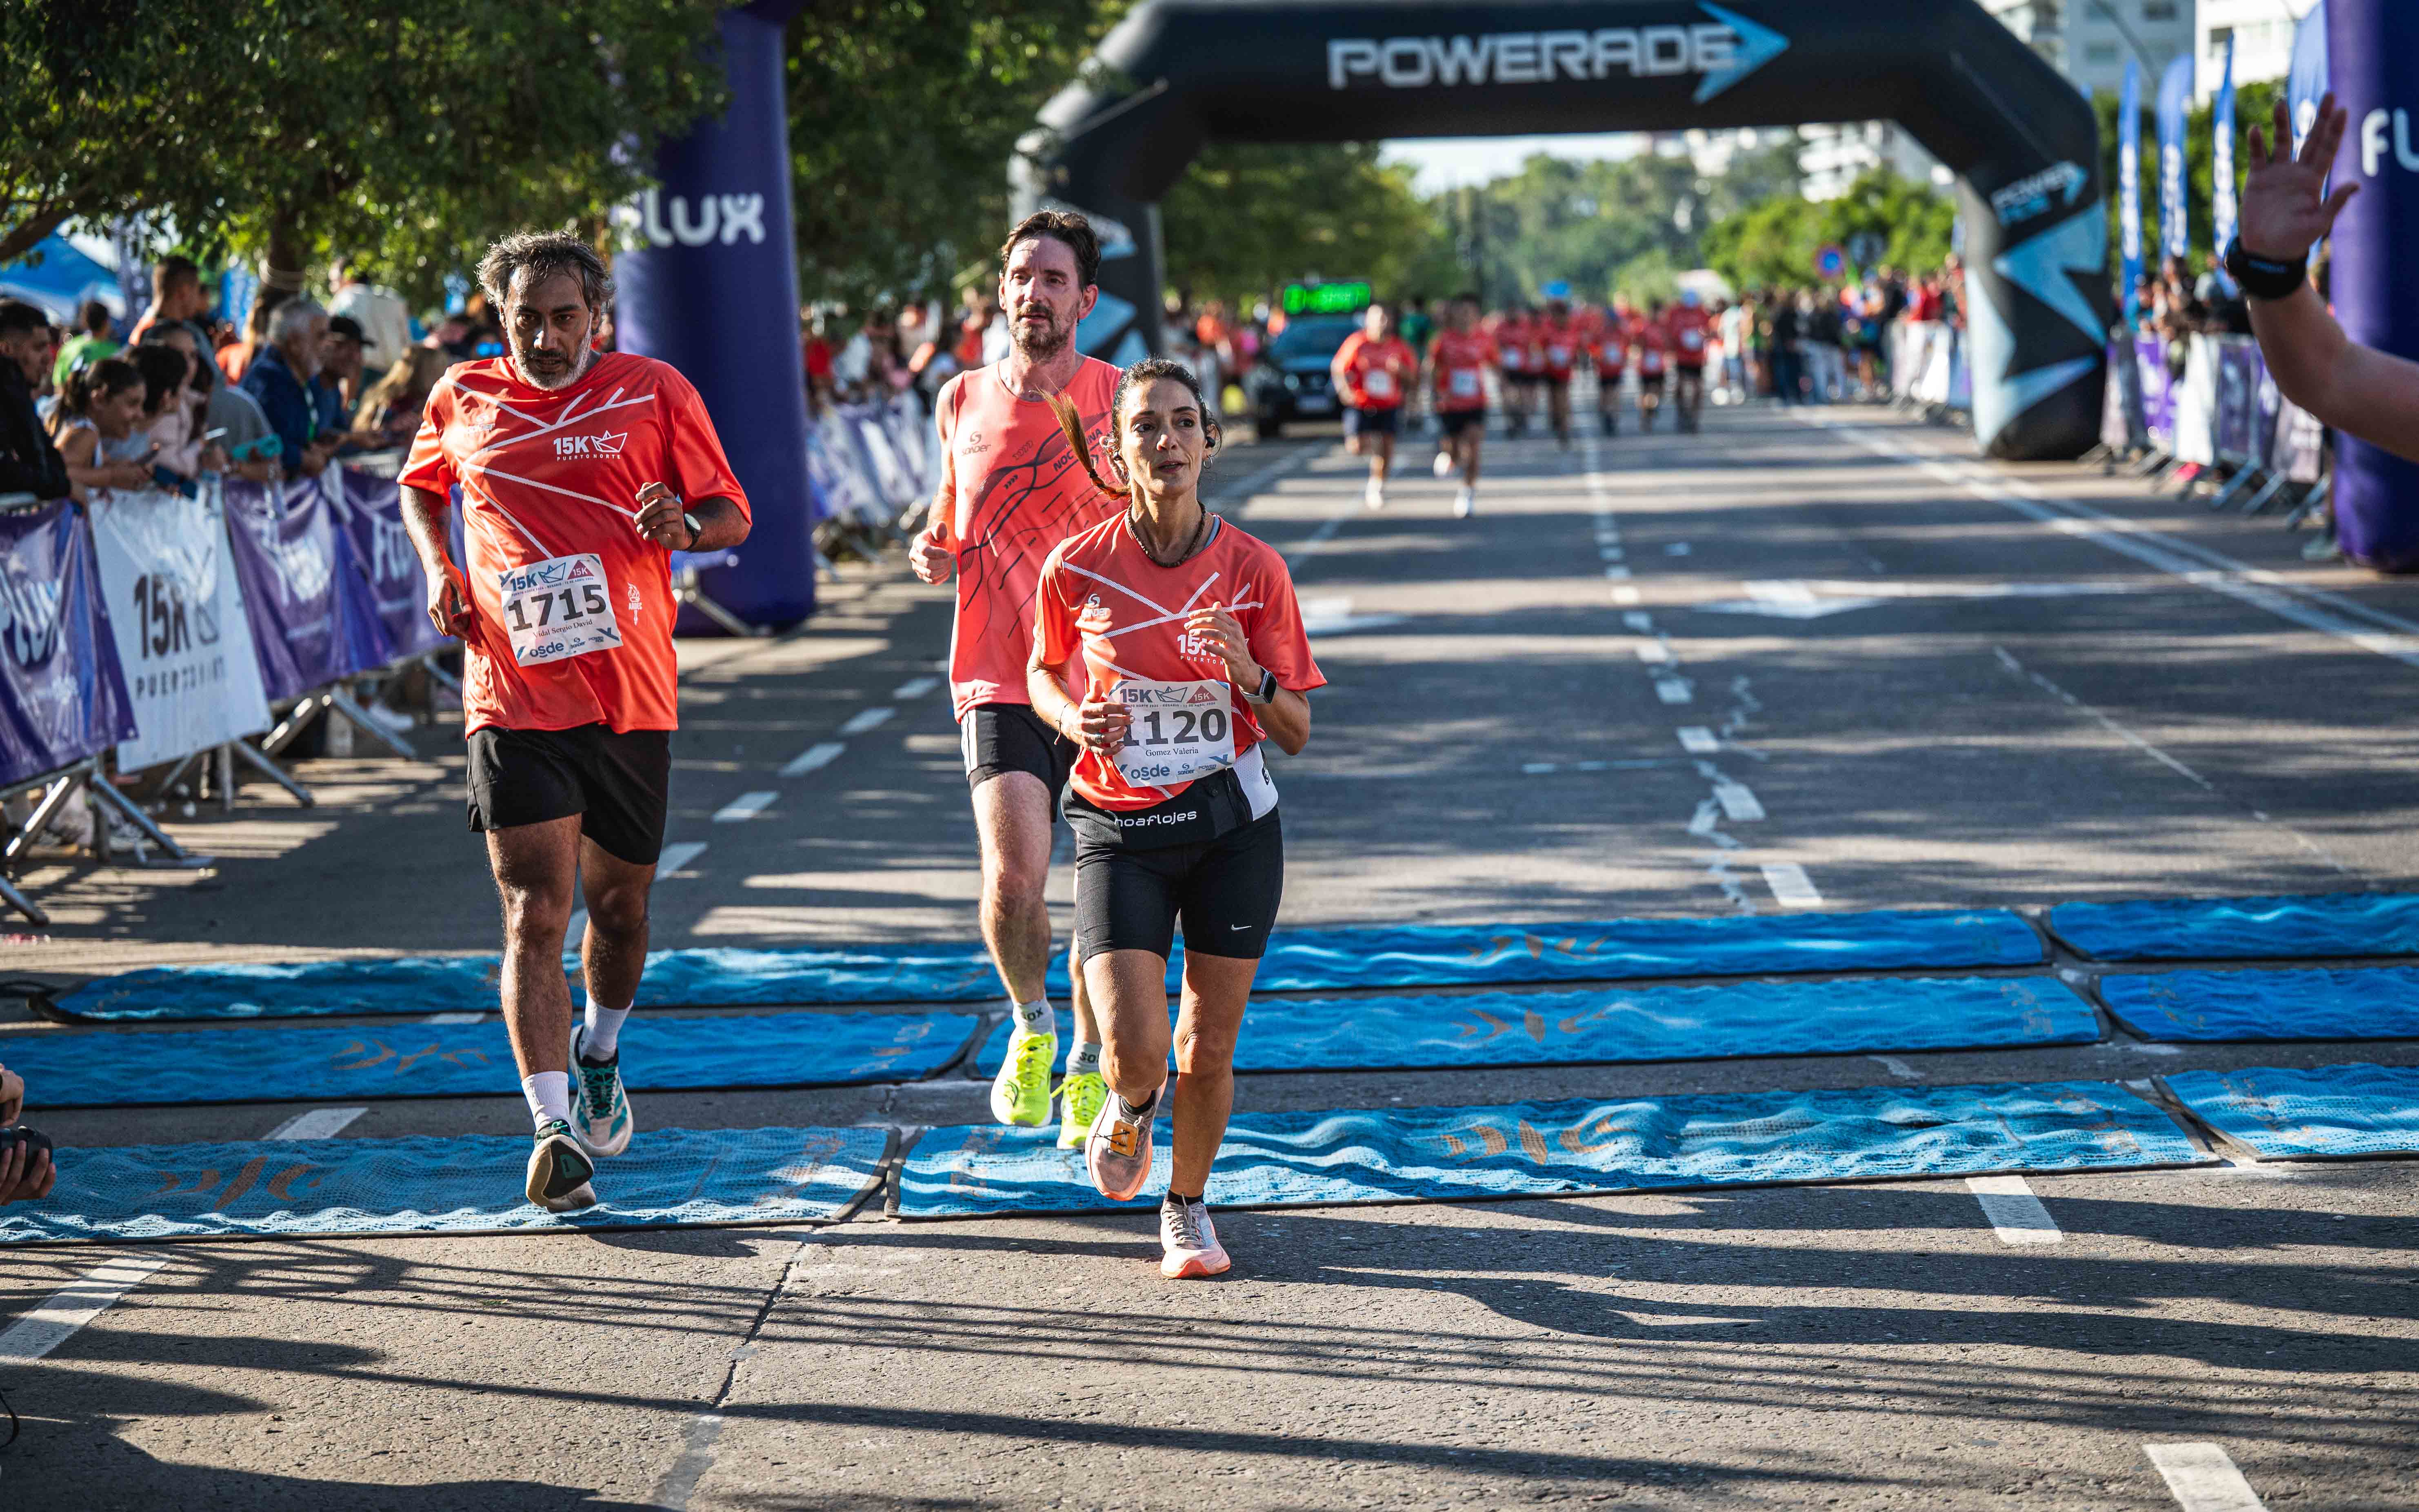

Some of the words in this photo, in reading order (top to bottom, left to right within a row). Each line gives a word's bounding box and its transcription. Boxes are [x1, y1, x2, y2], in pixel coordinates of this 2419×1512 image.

[1326, 23, 1738, 90] POWERADE
[553, 436, 589, 455] 15K
[510, 572, 538, 591] 15K
[572, 567, 587, 576] 15K
[508, 584, 606, 632] 1715
[533, 629, 551, 638] Vidal
[551, 624, 572, 634] Sergio
[573, 619, 593, 629] David
[530, 641, 564, 658] osde
[1177, 634, 1217, 657] 15K
[1180, 655, 1216, 664] PUERTO
[1120, 688, 1153, 703] 15K
[1194, 692, 1210, 701] 15K
[1173, 747, 1199, 755] Valeria
[1131, 764, 1170, 780] osde
[1079, 1051, 1098, 1063] SO
